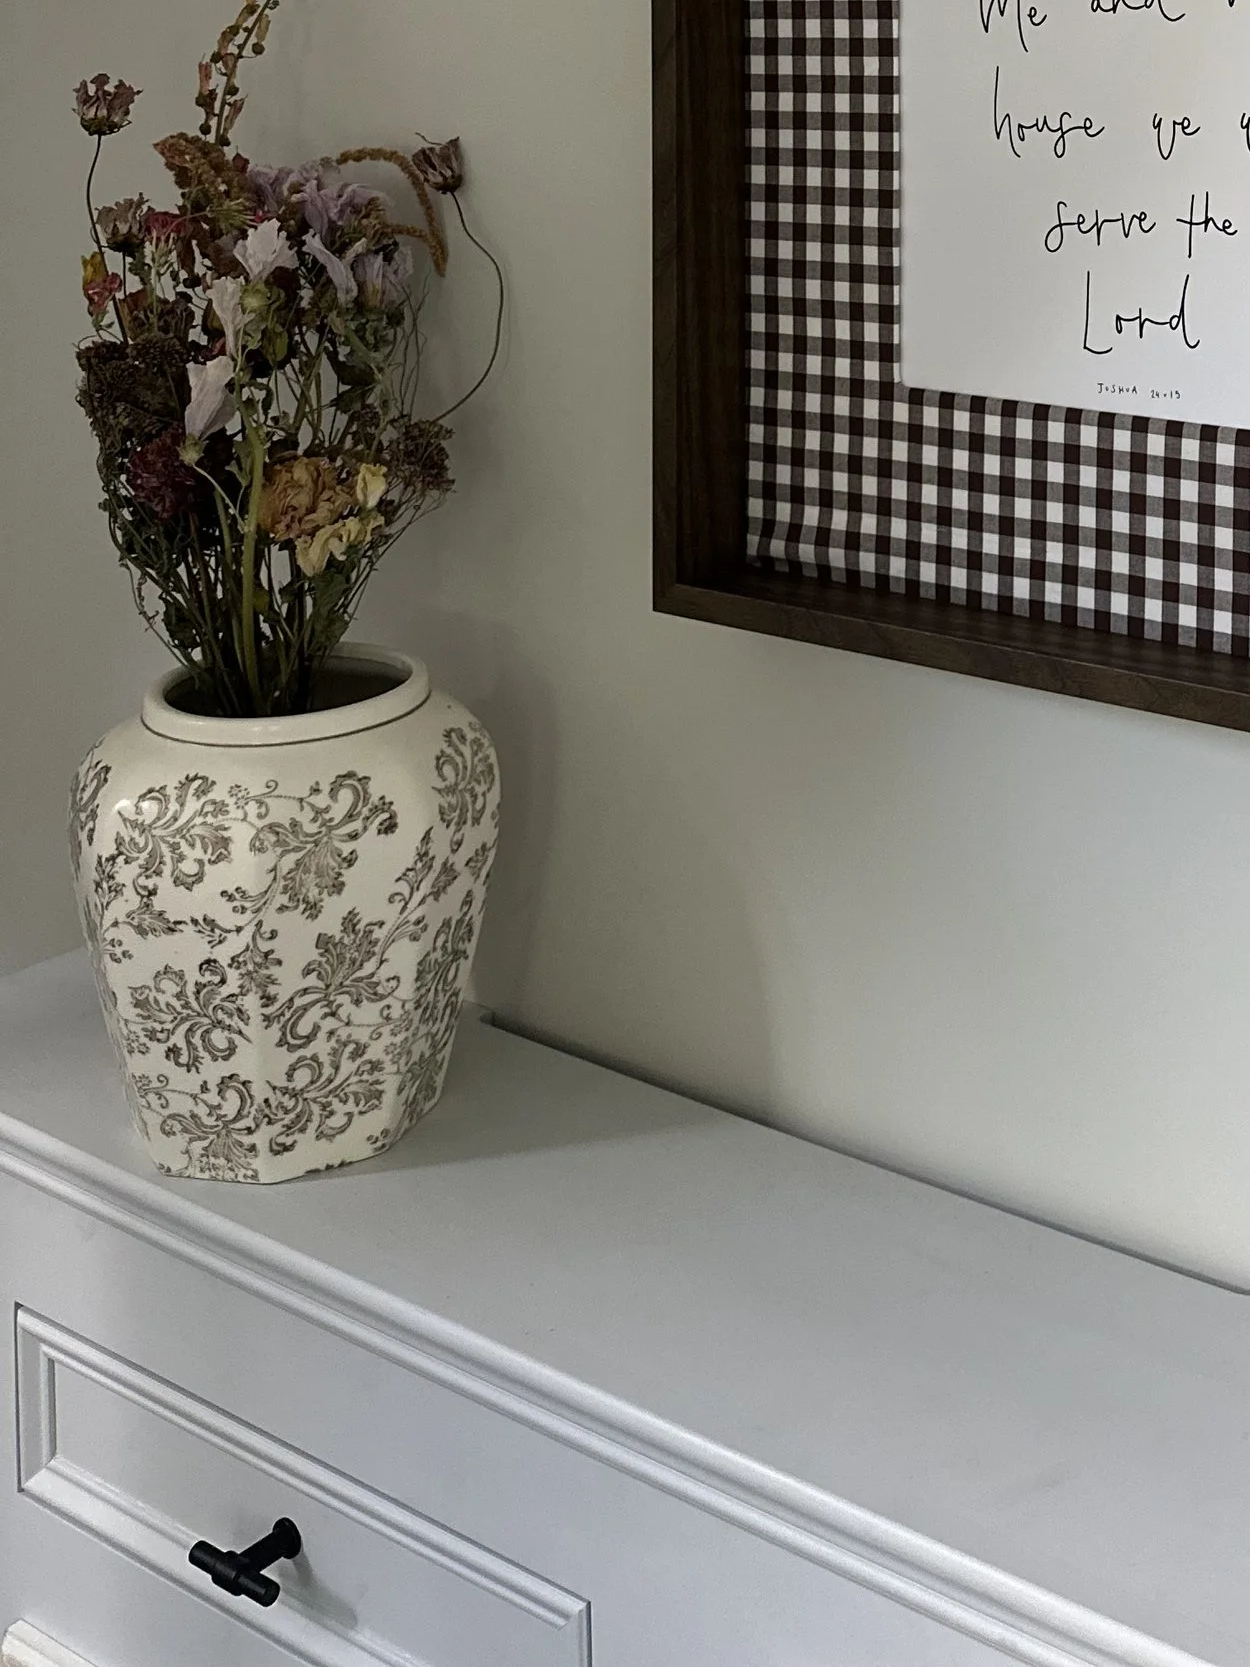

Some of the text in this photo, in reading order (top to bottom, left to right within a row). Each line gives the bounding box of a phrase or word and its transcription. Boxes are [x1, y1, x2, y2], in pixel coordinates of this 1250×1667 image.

[993, 65, 1106, 159] house
[1151, 112, 1202, 161] we
[1044, 190, 1239, 260] serve the
[1082, 269, 1201, 356] Lord
[1097, 382, 1138, 395] JOSHUA
